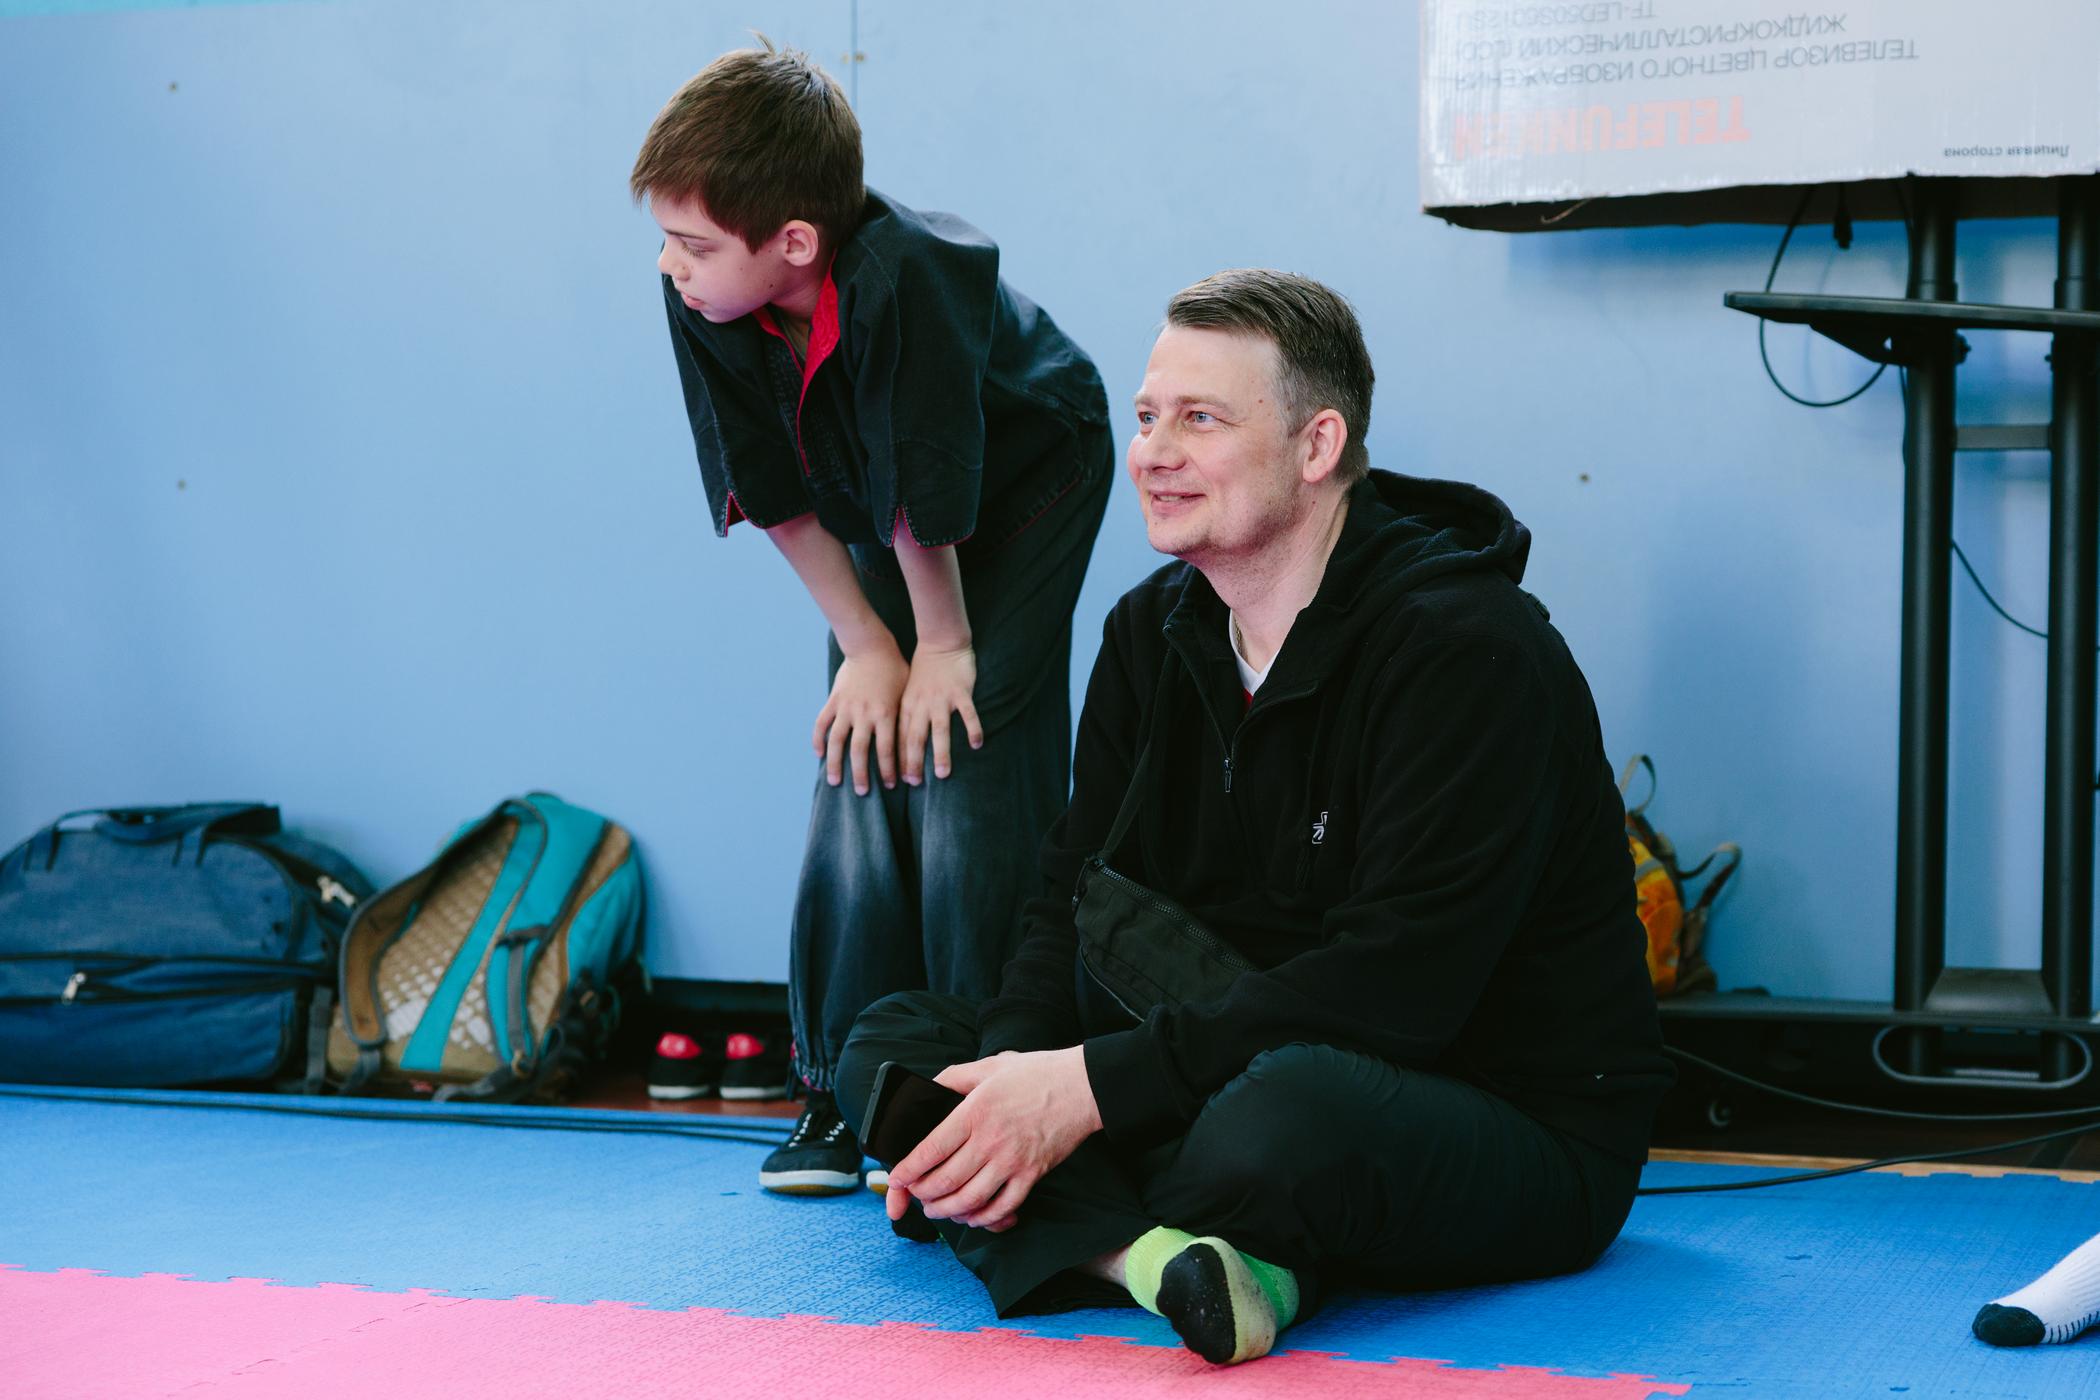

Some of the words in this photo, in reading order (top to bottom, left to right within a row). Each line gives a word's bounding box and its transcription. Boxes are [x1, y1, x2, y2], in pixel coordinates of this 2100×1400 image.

[1520, 13, 1847, 57] ЖИДКОКРИСТАЛЛИЧЕСКИЙ
[1641, 48, 1767, 79] ЦВЕТНОГО
[1774, 39, 1919, 69] ТЕЛЕВИЗОР
[1455, 61, 1633, 90] ИЗОБРАЖЕНИЯ
[1455, 96, 1750, 161] TELEFUNKEN
[1944, 145, 2003, 158] сторона
[2006, 144, 2070, 158] Лицевая
